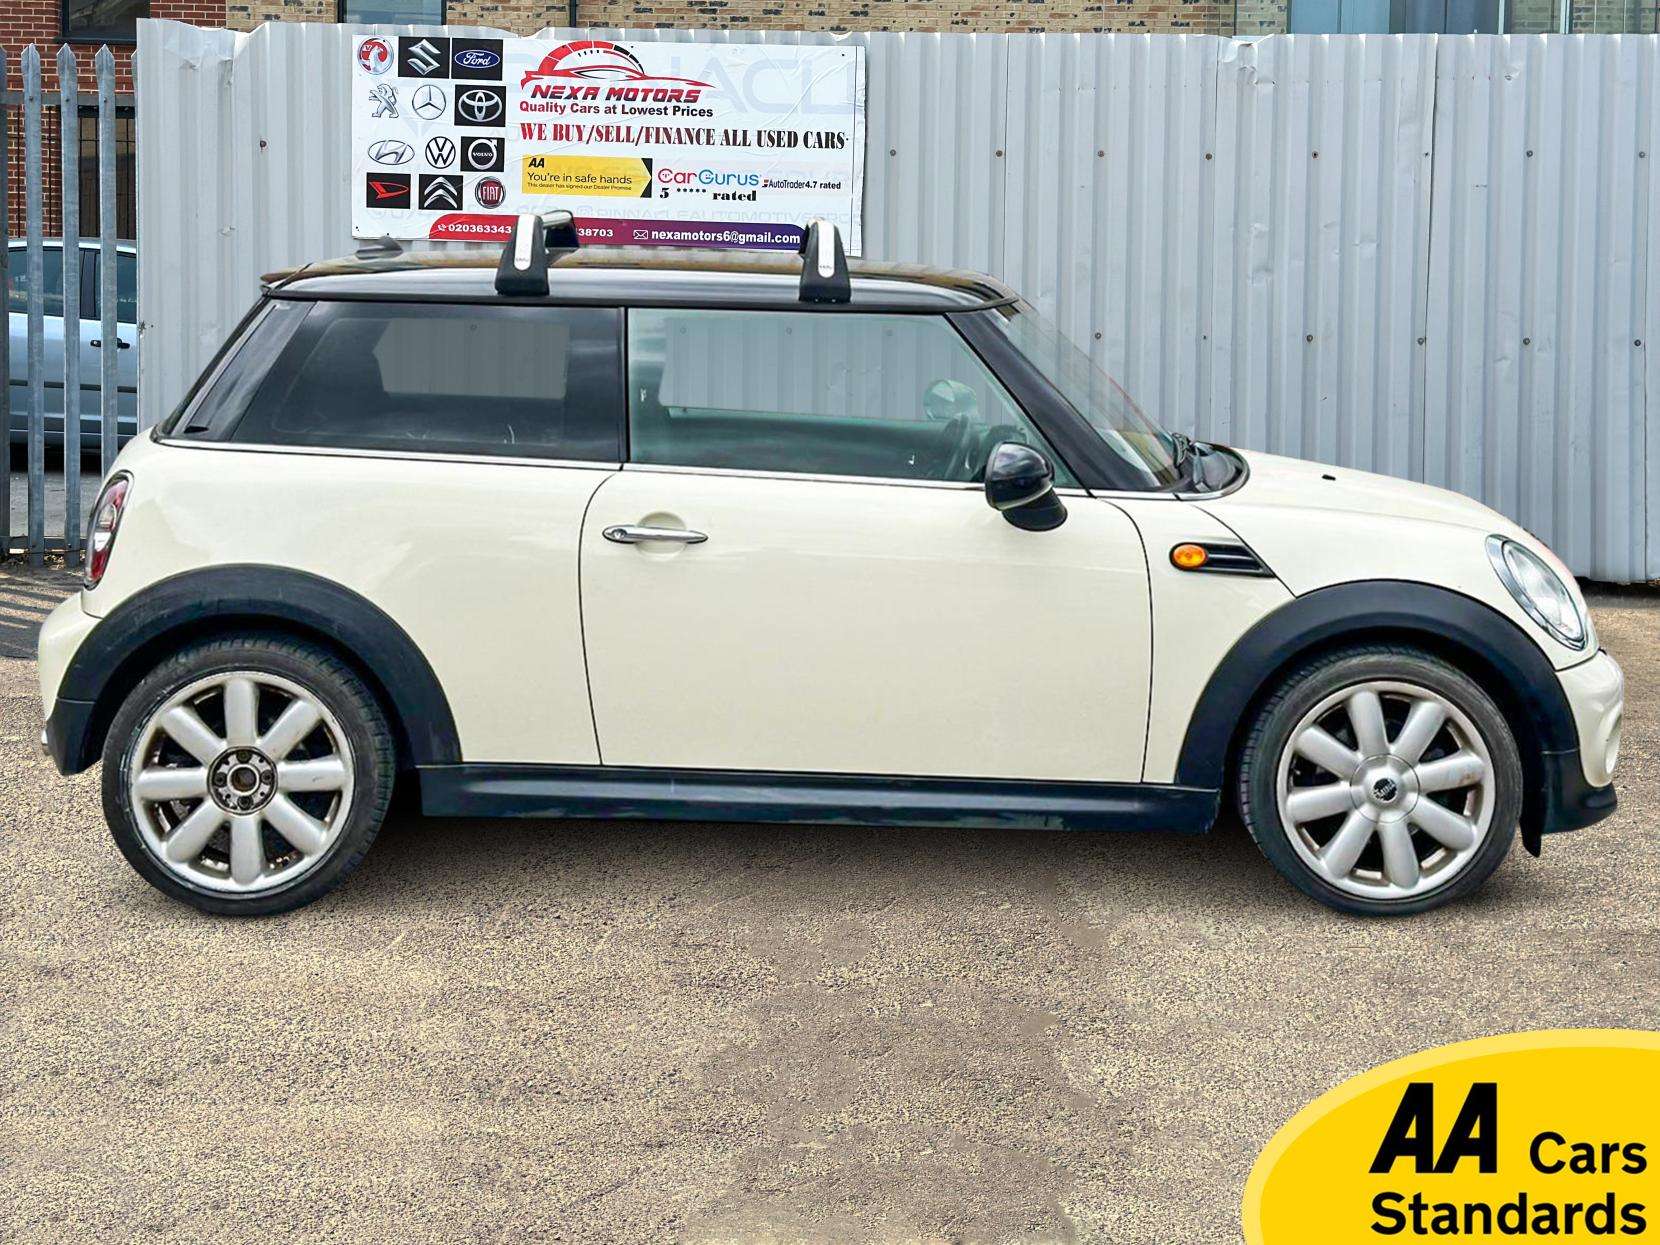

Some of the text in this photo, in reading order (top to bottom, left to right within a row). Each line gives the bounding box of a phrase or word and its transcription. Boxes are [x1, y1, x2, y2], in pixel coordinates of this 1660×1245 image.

[463, 52, 491, 66] Ford
[531, 85, 702, 104] NEXA MOTORS
[520, 101, 714, 117] Quality Cars at Lowest Prices
[520, 123, 547, 141] WE
[720, 129, 752, 146] ALL
[757, 130, 799, 148] USED
[528, 157, 545, 168] AA
[527, 172, 632, 184] You're in safe hands
[658, 168, 760, 187] CarGurus
[819, 181, 841, 189] rated
[482, 186, 499, 200] FIAT
[659, 187, 757, 201] 5 rated
[448, 224, 614, 237] 020363343 38703
[651, 229, 800, 245] nexamotors6@gmail.com
